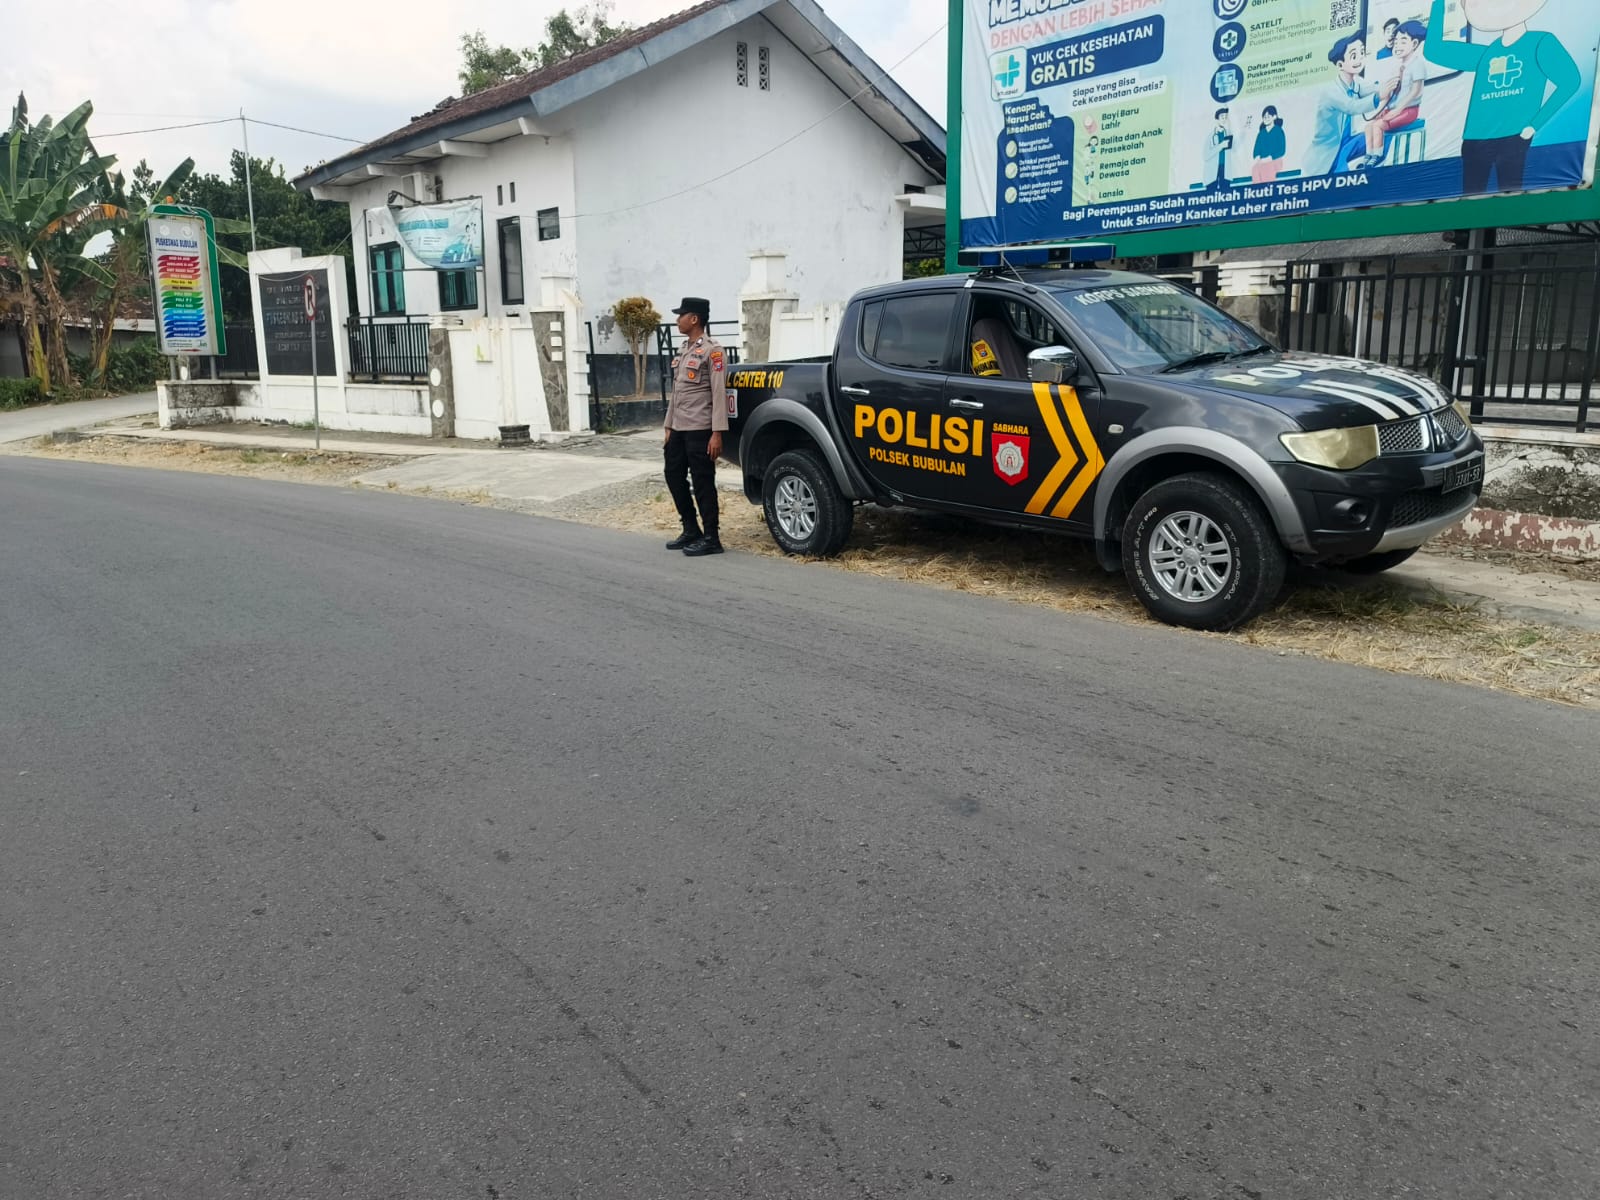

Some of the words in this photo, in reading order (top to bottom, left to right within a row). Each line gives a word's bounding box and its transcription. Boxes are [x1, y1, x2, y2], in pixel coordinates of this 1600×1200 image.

[991, 16, 1056, 49] DENGAN
[1061, 3, 1105, 30] LEBIH
[1109, 0, 1164, 17] SEH
[1250, 18, 1283, 31] SATELIT
[1249, 29, 1275, 40] Saluran
[1249, 35, 1286, 47] Puskesmas
[1031, 52, 1054, 66] YUK
[1056, 45, 1079, 60] CEK
[1080, 24, 1154, 53] KESEHATAN
[1031, 55, 1095, 85] GRATIS
[1247, 62, 1269, 72] Daftar
[1270, 55, 1304, 67] langsung
[1247, 67, 1286, 79] Puskesmas
[1072, 87, 1095, 98] Siapa
[1096, 81, 1117, 93] Yang
[1118, 77, 1136, 88] Bisa
[1072, 98, 1088, 107] Cek
[1088, 88, 1132, 103] Kesehatan
[1133, 80, 1164, 94] Gratis?
[1481, 87, 1525, 100] SATUSEHAT
[1005, 103, 1037, 115] Kenapa
[1030, 111, 1046, 120] Cek
[1101, 111, 1119, 121] Bayi
[1120, 108, 1140, 118] Baru
[1101, 120, 1121, 131] Lahir
[1100, 135, 1124, 146] Balita
[1124, 131, 1140, 141] dan
[1141, 127, 1163, 138] Anak
[1100, 141, 1145, 155] Prasekolah
[1099, 159, 1129, 171] Remaja
[1130, 157, 1146, 166] dan
[1099, 169, 1130, 180] Dewasa
[1062, 207, 1085, 221] Bagi
[1087, 201, 1147, 218] Perempuan
[1149, 197, 1185, 210] Sudah
[1187, 189, 1241, 207] menikah
[1243, 184, 1273, 199] ikuti
[1276, 183, 1299, 195] Tes
[1302, 178, 1332, 193] HPV
[1335, 173, 1369, 188] DNA
[1098, 189, 1124, 199] Lansia
[1101, 216, 1134, 230] Untuk
[1136, 211, 1183, 226] Skrining
[1185, 206, 1228, 221] Kanker
[1231, 202, 1268, 216] Leher
[1270, 197, 1309, 212] rahim
[1074, 288, 1126, 306] KORPS
[733, 370, 767, 388] CENTER
[767, 370, 784, 389] 110
[854, 404, 984, 457] POLISI
[992, 422, 1029, 435] SABHARA
[869, 446, 910, 467] POLSEK
[912, 454, 966, 477] BUBULAN
